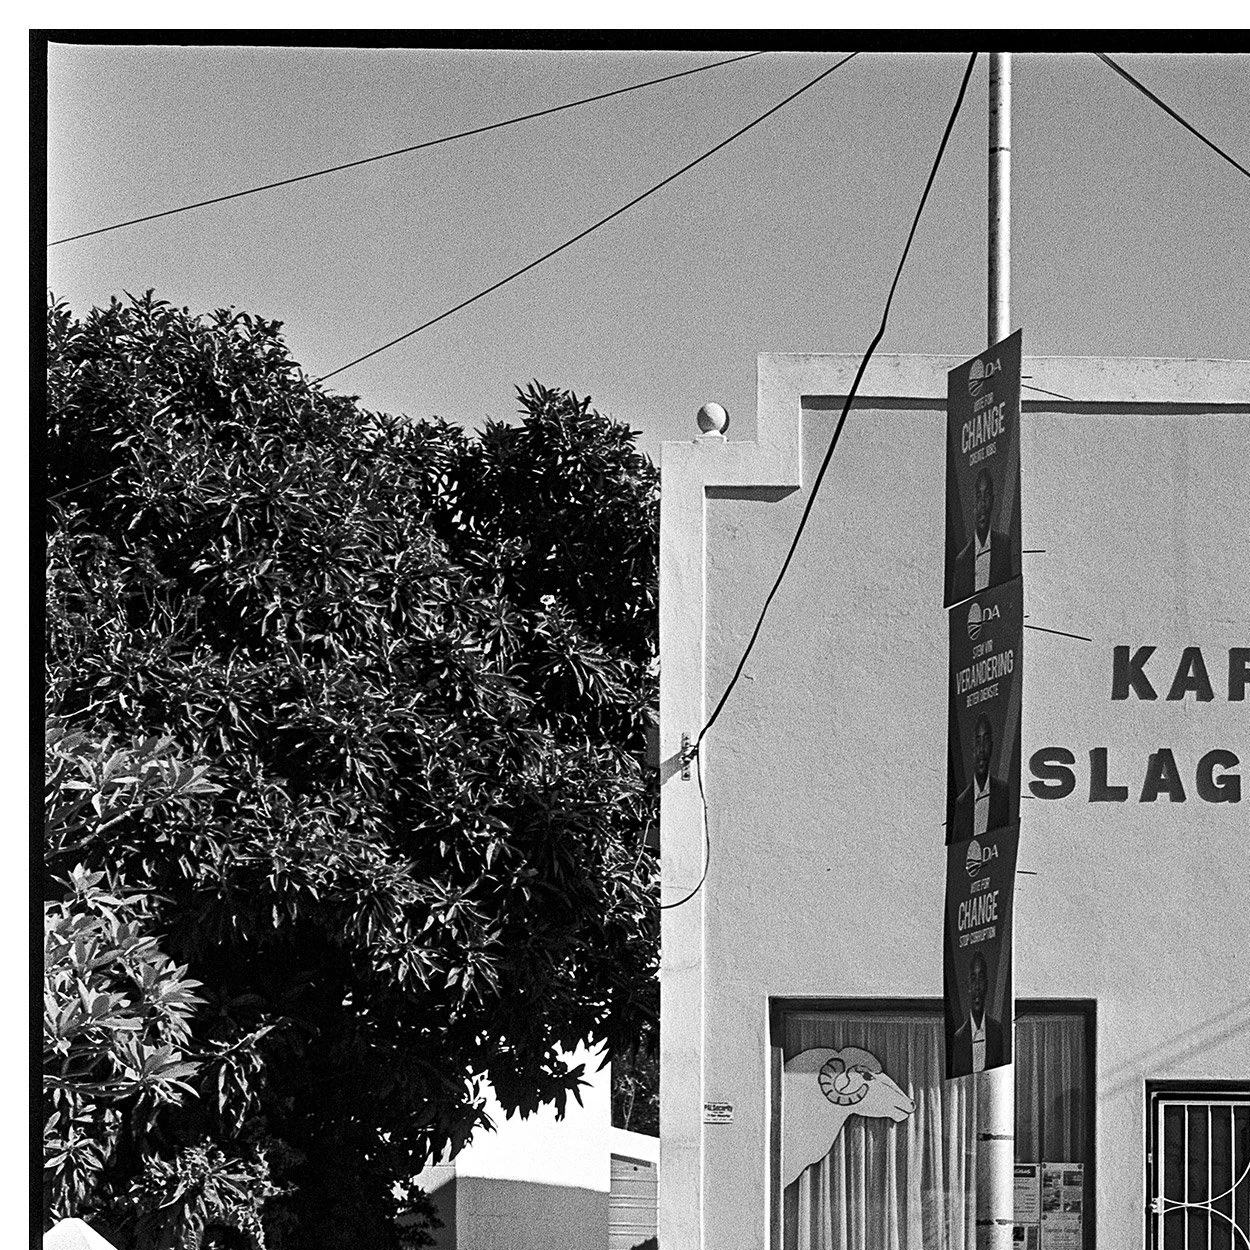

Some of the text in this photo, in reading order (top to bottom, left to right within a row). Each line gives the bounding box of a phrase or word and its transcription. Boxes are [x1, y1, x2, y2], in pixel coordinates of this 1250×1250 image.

[985, 358, 1002, 378] DA
[962, 401, 1006, 454] CHANGE
[983, 605, 1000, 622] DA
[956, 649, 1013, 695] VERANDERING
[982, 844, 999, 862] DA
[958, 890, 999, 931] CHANGE
